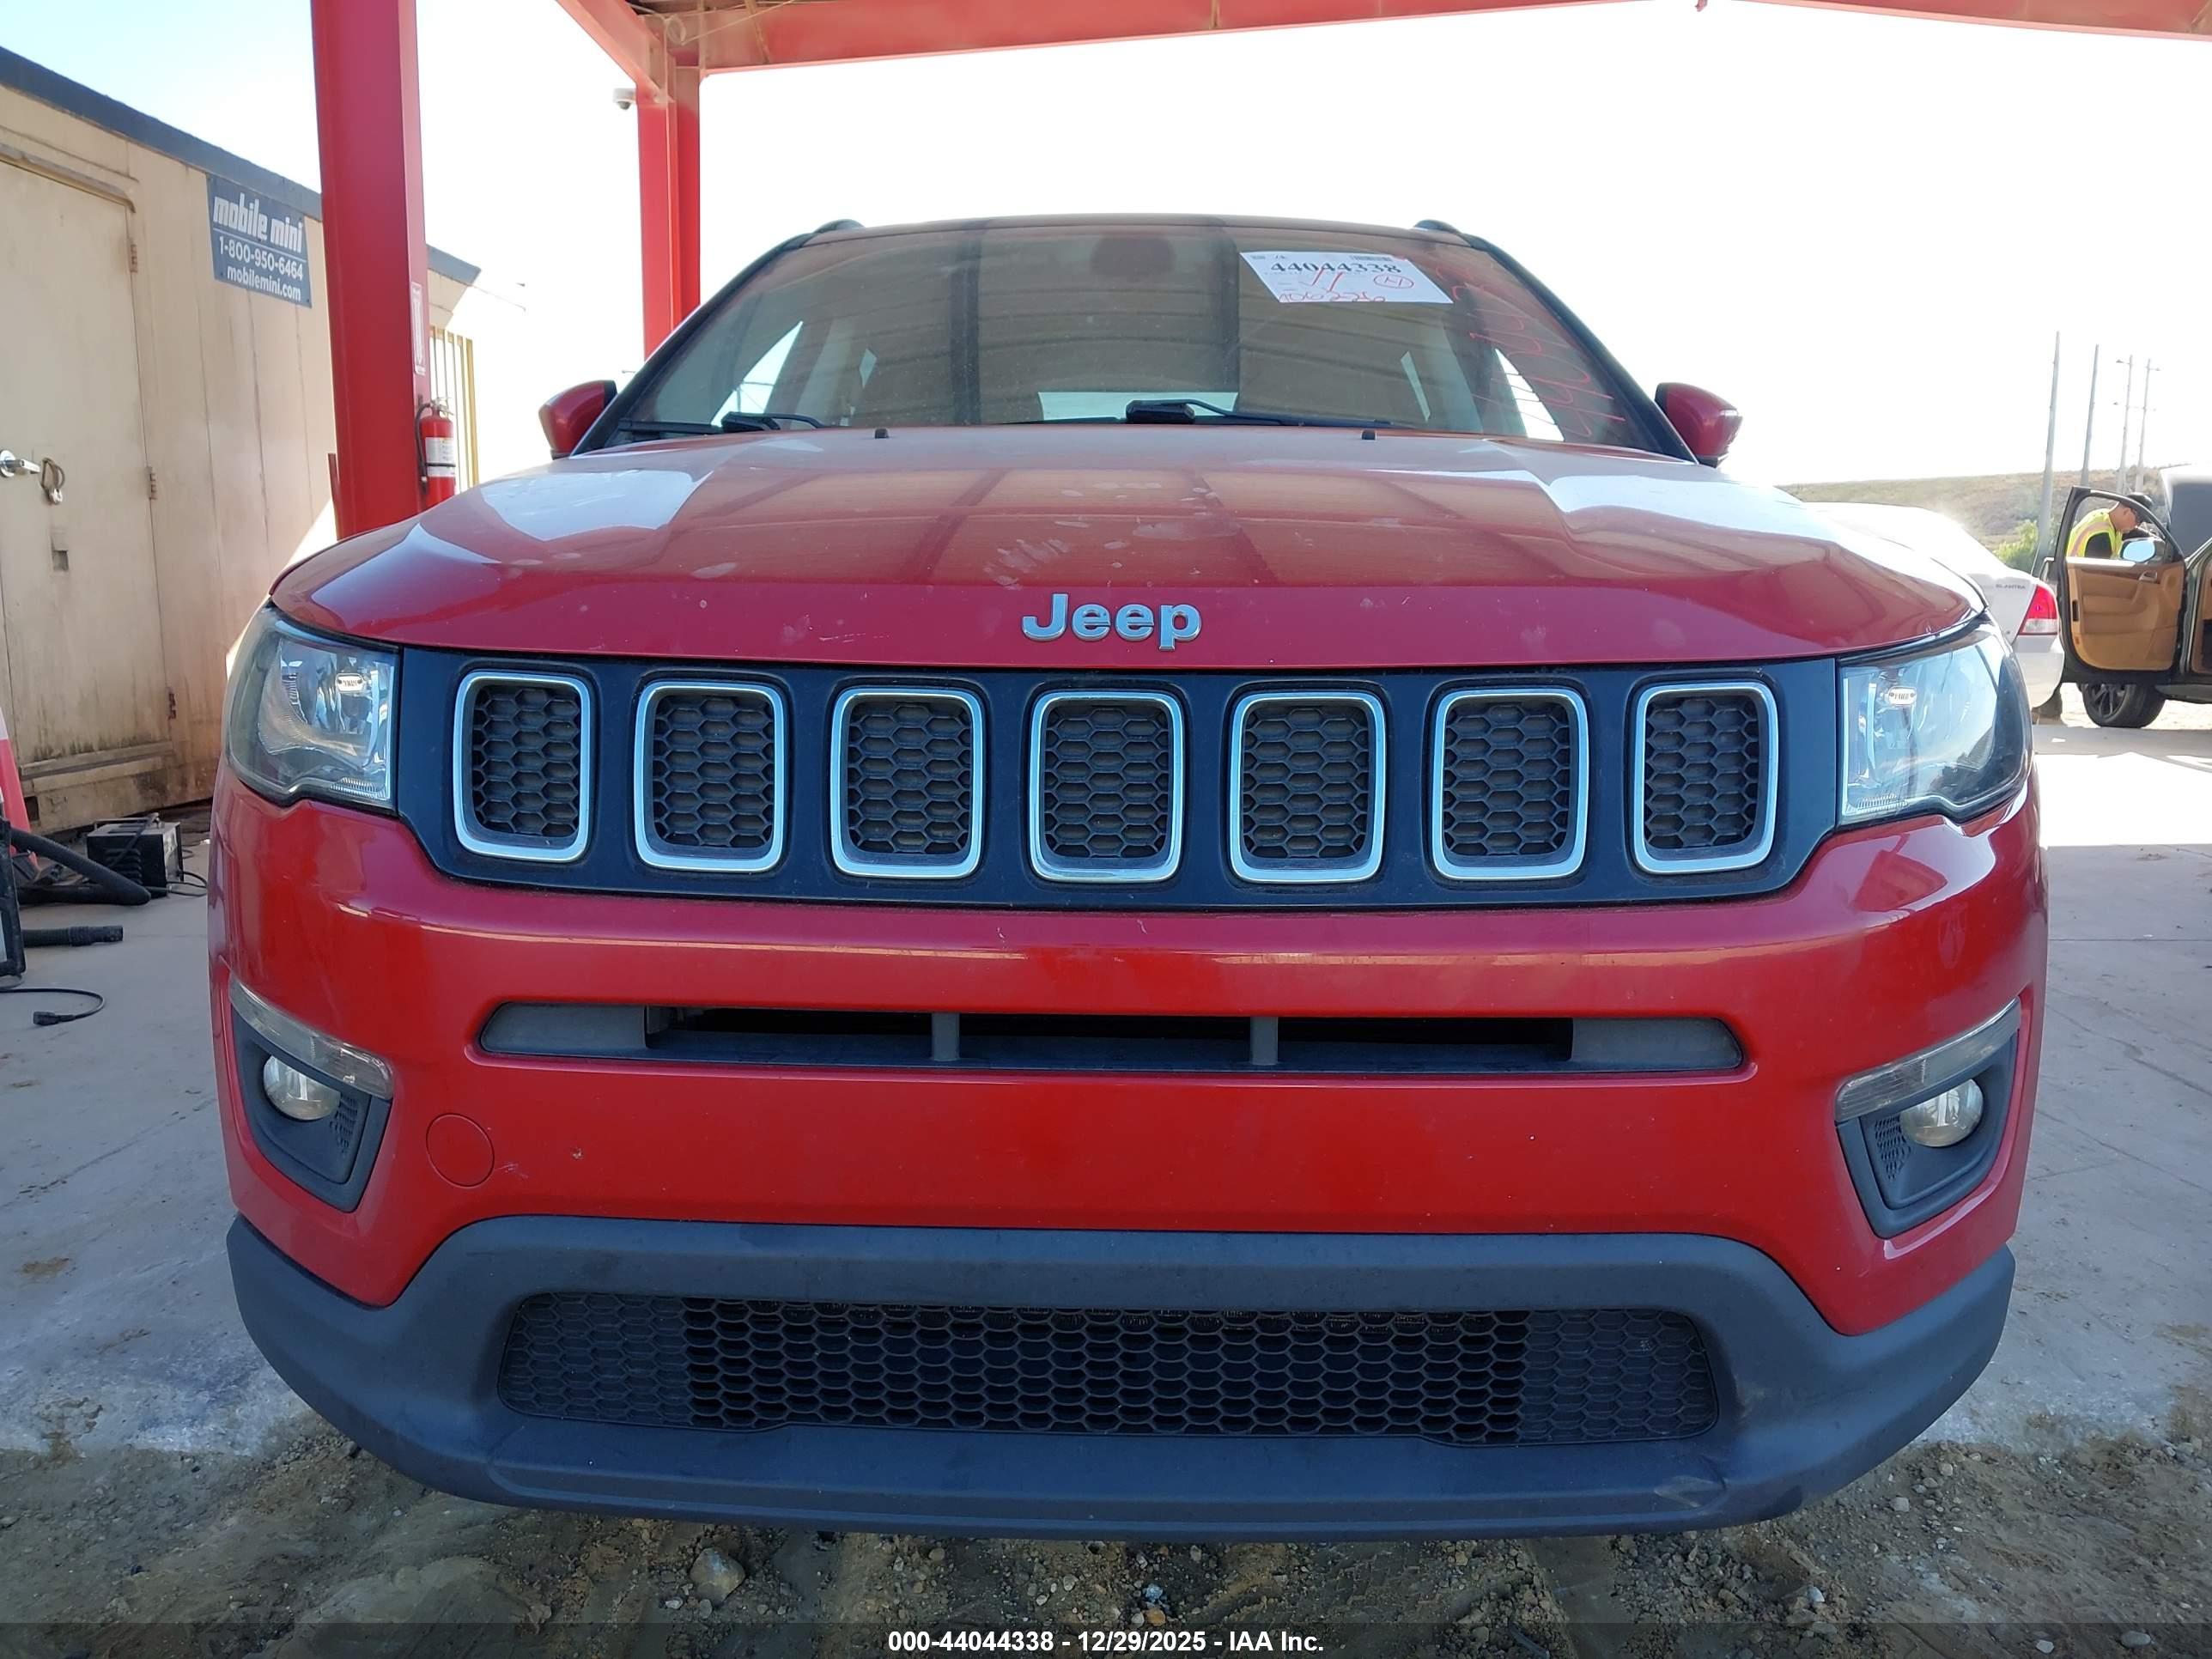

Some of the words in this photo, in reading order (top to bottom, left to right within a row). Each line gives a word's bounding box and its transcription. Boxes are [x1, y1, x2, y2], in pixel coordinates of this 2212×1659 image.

[214, 192, 268, 241] mobile
[270, 216, 303, 253] mini
[219, 235, 304, 281] 1-800-950-6464
[1271, 262, 1402, 274] 44044338
[227, 265, 301, 301] mobilemini.com
[1021, 592, 1202, 651] Jeep
